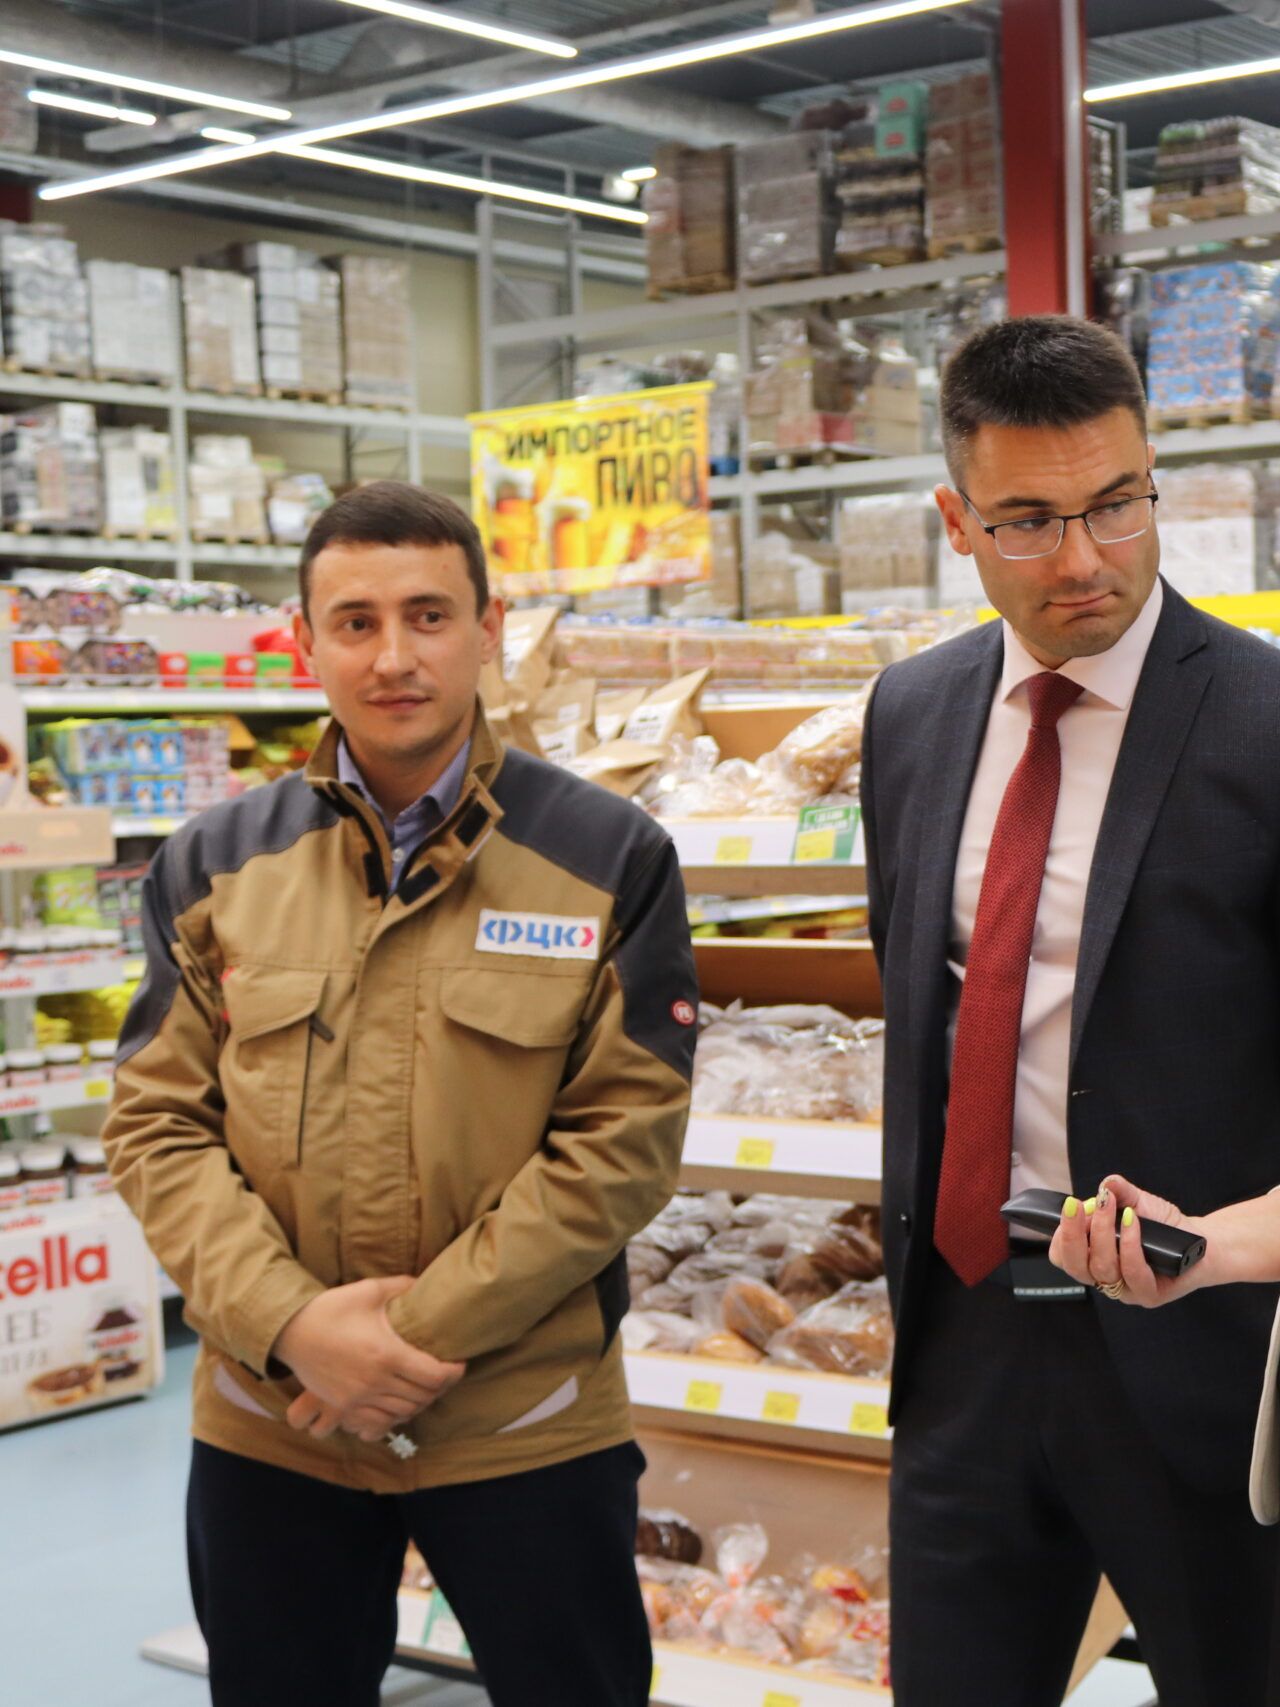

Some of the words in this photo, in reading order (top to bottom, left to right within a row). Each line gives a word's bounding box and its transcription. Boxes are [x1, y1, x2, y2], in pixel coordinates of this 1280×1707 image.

[505, 407, 696, 461] ИМПОРТНОЕ
[597, 446, 700, 509] ПИВО
[0, 1234, 109, 1300] ella
